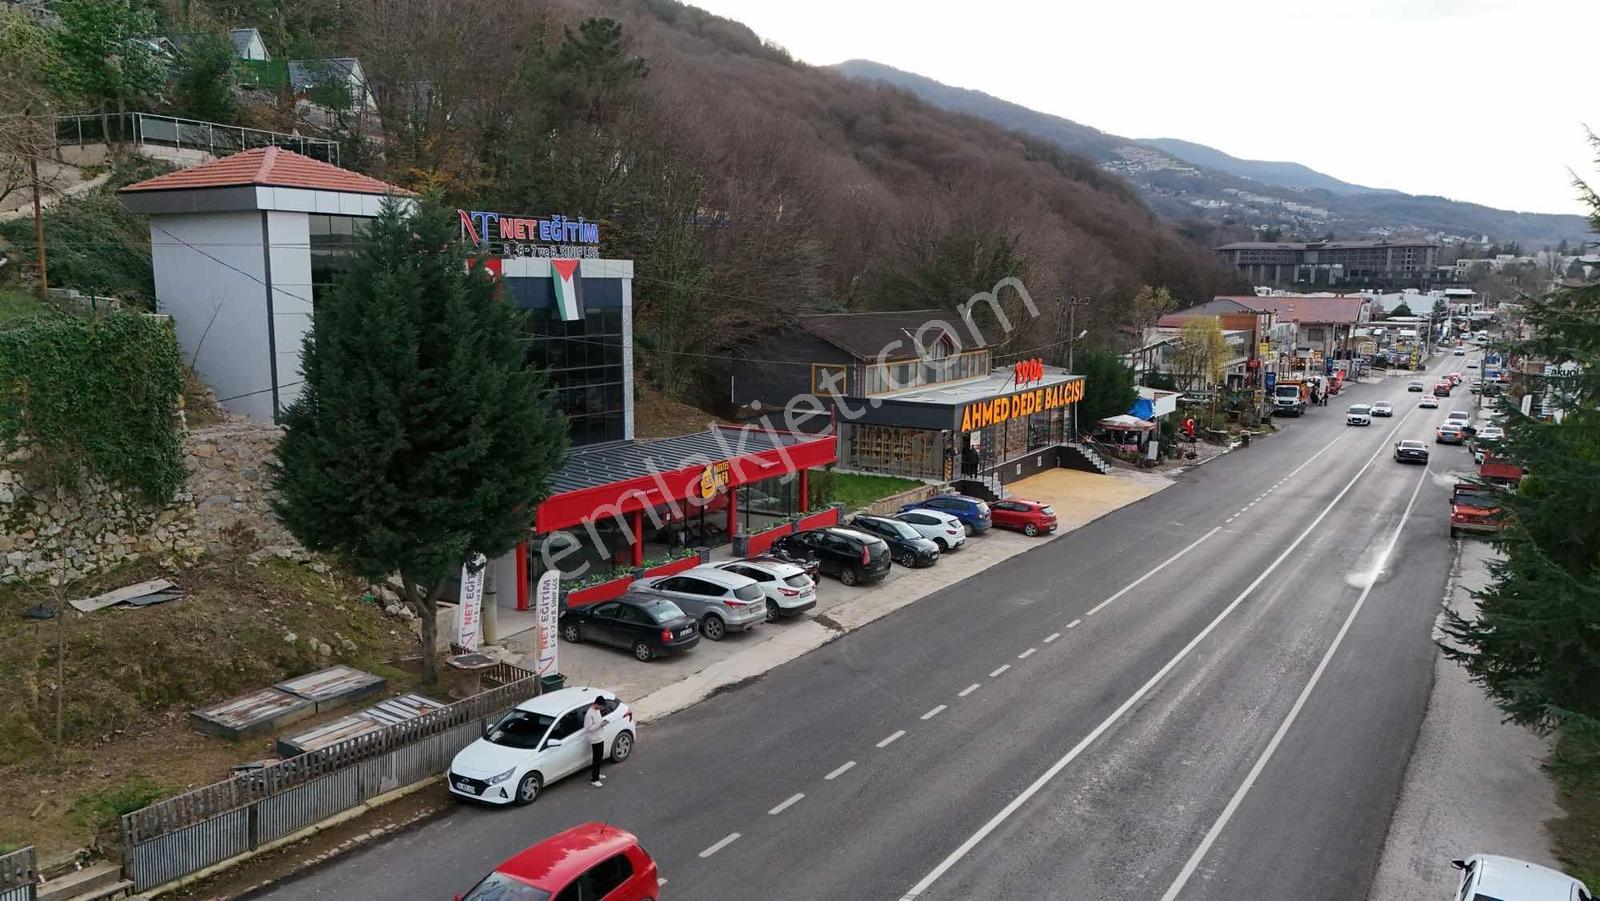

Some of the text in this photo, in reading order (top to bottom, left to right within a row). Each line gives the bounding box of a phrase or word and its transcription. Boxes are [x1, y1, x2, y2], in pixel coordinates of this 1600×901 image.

[500, 218, 537, 240] NET
[539, 214, 599, 243] EĞİTİM
[961, 379, 1085, 432] AHMED DEDE BALCISI
[464, 601, 473, 626] NET
[539, 579, 551, 623] EĞİTİM
[539, 626, 549, 650] NET
